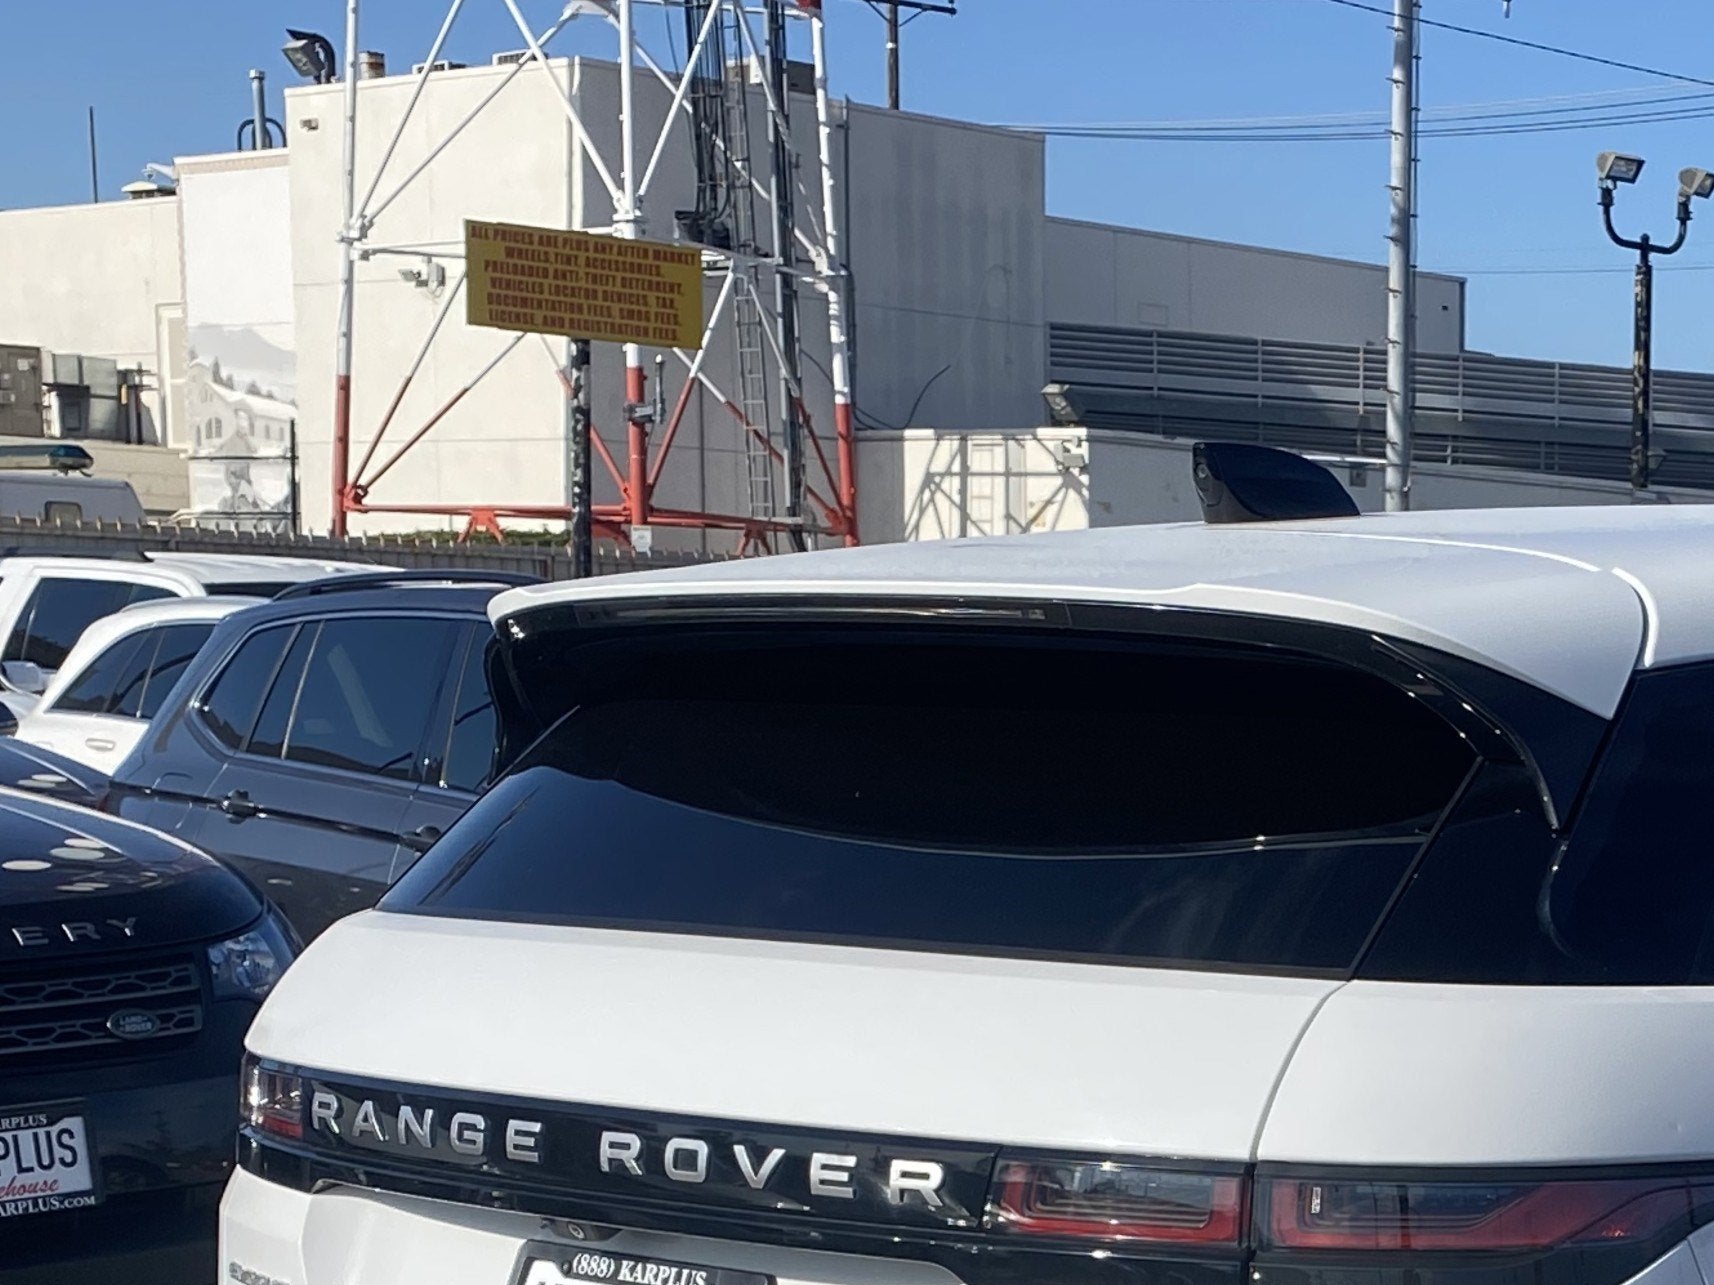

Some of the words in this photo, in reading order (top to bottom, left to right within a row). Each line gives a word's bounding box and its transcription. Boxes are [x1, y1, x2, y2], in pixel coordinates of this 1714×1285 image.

[493, 229, 534, 245] PRICES
[537, 235, 560, 249] ARE
[562, 237, 590, 253] PLUS
[593, 241, 613, 255] ANY
[617, 244, 649, 260] AFTER
[652, 249, 696, 266] MARKET
[484, 259, 549, 279] PRELOADED
[490, 277, 545, 295] VEHICLES
[548, 283, 599, 301] LOCATOR
[487, 292, 584, 315] DOCUMENTATION
[568, 317, 649, 338] REGISTRATION
[310, 1091, 544, 1164] RANGE
[599, 1130, 945, 1207] ROVER
[572, 1253, 616, 1278] (888)
